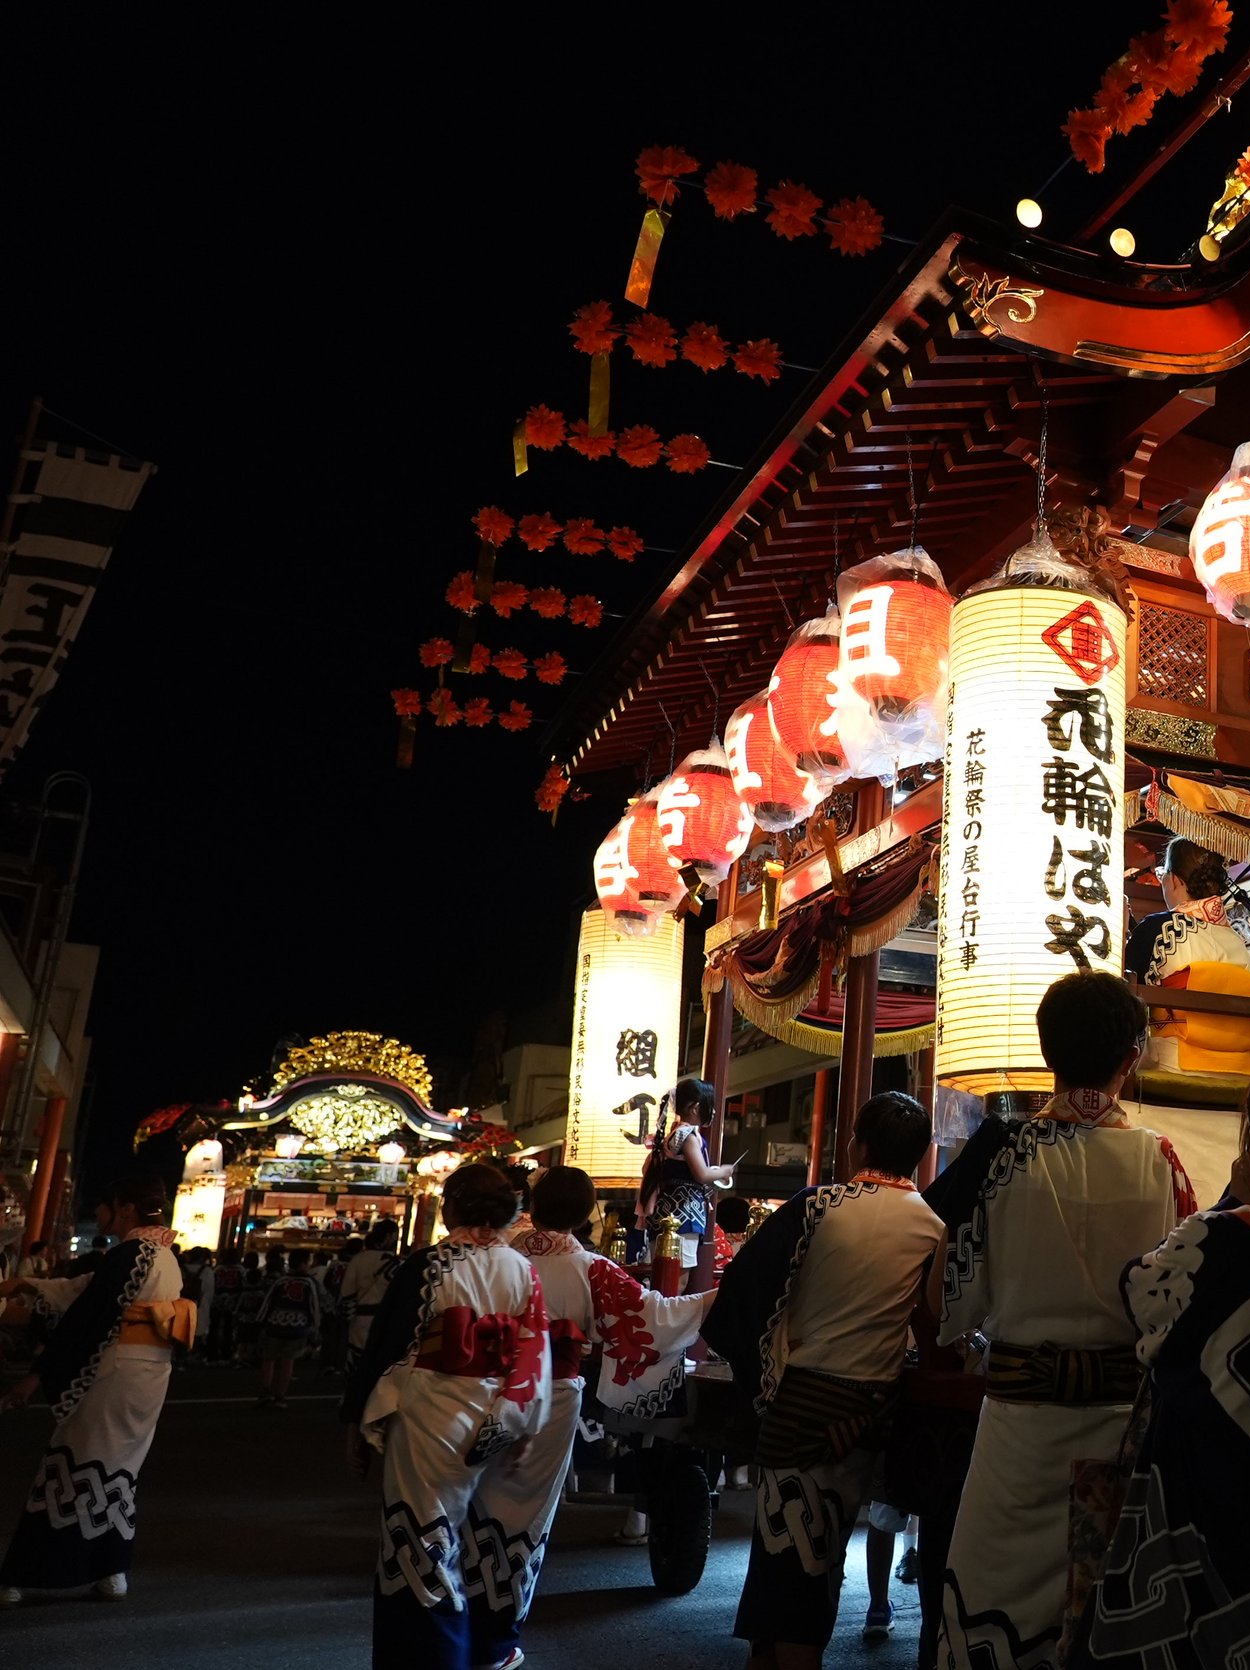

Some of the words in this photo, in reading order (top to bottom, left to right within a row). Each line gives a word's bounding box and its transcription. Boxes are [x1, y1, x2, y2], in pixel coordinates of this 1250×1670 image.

[960, 727, 987, 971] 花輪祭の屋台行事
